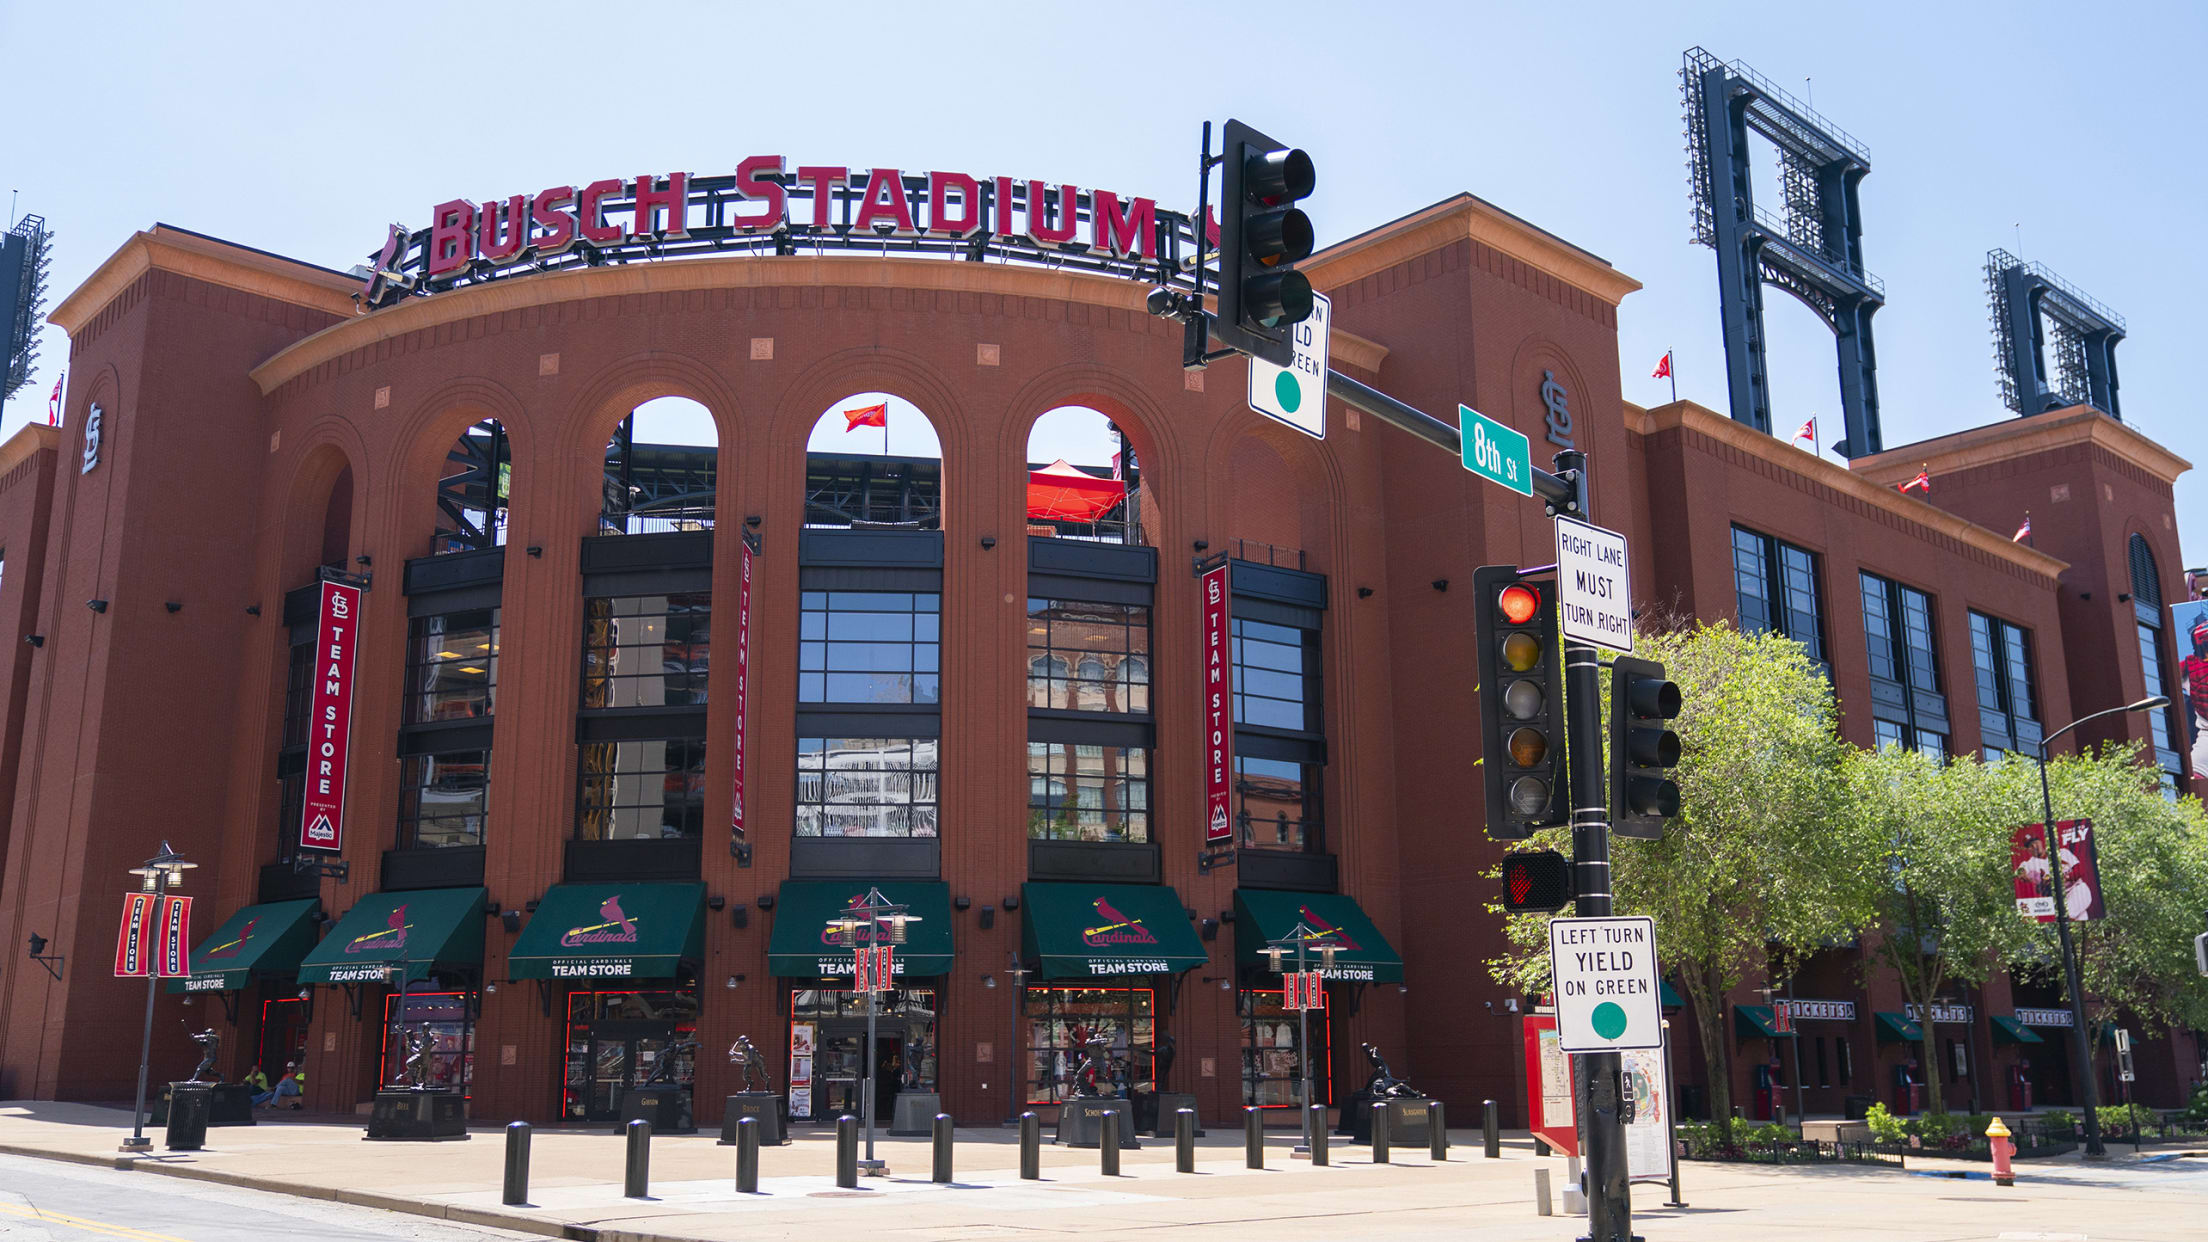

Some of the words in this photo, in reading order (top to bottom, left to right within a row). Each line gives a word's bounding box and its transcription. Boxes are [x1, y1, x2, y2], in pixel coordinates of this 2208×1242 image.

[429, 171, 694, 282] BUSCH
[733, 155, 1159, 264] STADIUM
[1474, 421, 1501, 475] 8th
[1506, 456, 1518, 482] St
[1562, 532, 1592, 558] RIGHT
[1597, 543, 1623, 568] LANE
[1576, 569, 1613, 600] MUST
[1565, 603, 1593, 627] TURN
[1599, 613, 1627, 636] RIGHT
[1210, 612, 1220, 683] TEAM
[326, 626, 343, 697] TEAM
[319, 705, 336, 795] STORE
[1212, 693, 1222, 785] STORE
[2061, 827, 2089, 845] FLY
[132, 900, 142, 928] TEAM
[171, 903, 179, 931] TEAM
[561, 927, 637, 947] Cardinals
[1082, 927, 1158, 947] Cardinals
[1561, 929, 1596, 944] LEFT
[1604, 928, 1644, 943] TURN
[128, 934, 136, 970] STORE
[1575, 952, 1633, 972] YIELD
[330, 971, 357, 980] TEAM
[552, 965, 587, 976] TEAM
[588, 964, 632, 976] STORE
[1088, 964, 1126, 974] TEAM
[1127, 962, 1169, 972] STORE
[1343, 970, 1374, 980] STORE
[185, 980, 202, 990] TEAM
[202, 979, 224, 990] STORE
[1565, 980, 1586, 996] ON
[1596, 979, 1648, 995] GREEN
[2022, 1010, 2067, 1026] TICKETS
